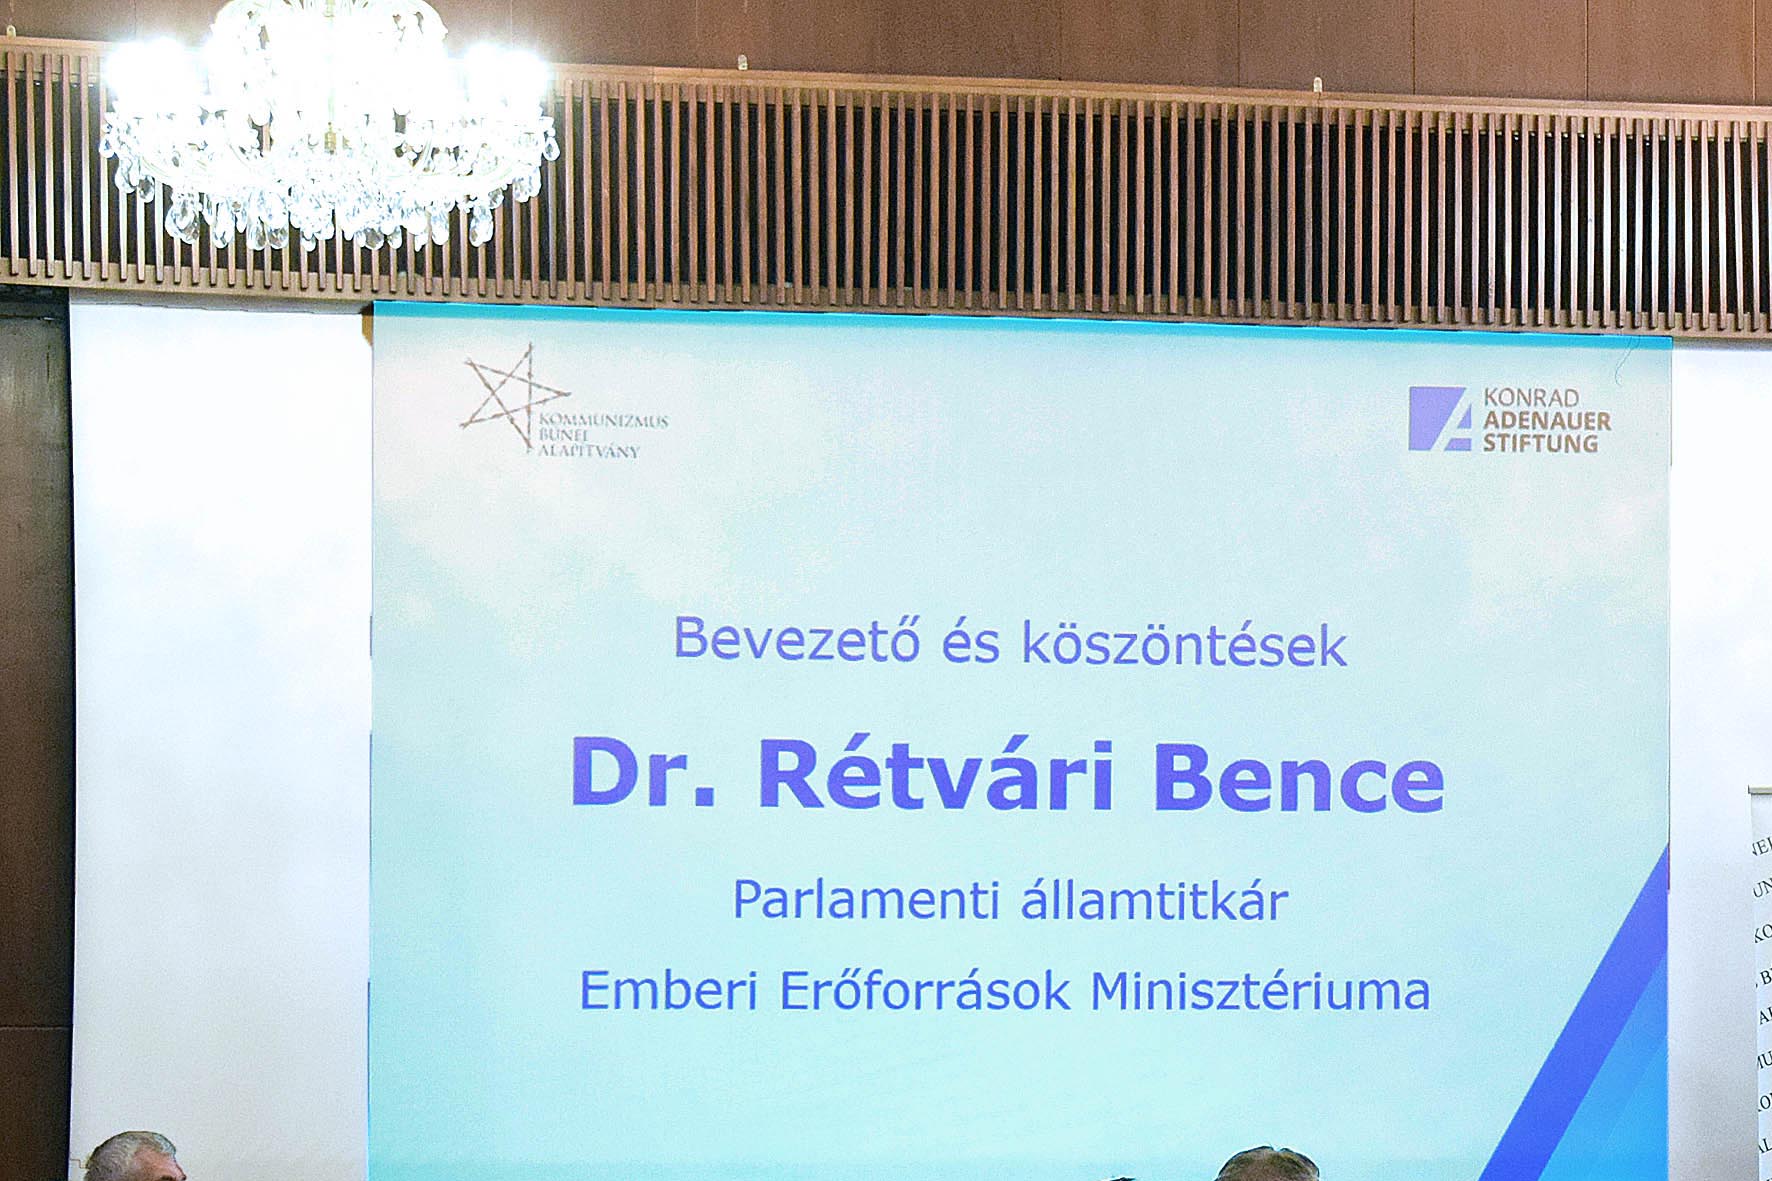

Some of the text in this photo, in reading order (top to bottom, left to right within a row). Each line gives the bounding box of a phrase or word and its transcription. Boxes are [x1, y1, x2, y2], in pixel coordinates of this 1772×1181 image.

[1484, 387, 1580, 407] KONRAD
[538, 412, 670, 429] KOMMUNIZMUS
[1483, 410, 1612, 431] ADENAUER
[1483, 433, 1599, 453] STIFTUNG
[676, 615, 1349, 667] Bevezető és köszöntések
[573, 732, 1444, 814] Dr. Rétvári Bence
[734, 876, 1289, 921] Parlamenti államtitkár
[581, 967, 1430, 1011] Emberi Erőforrások Minisztériuma
